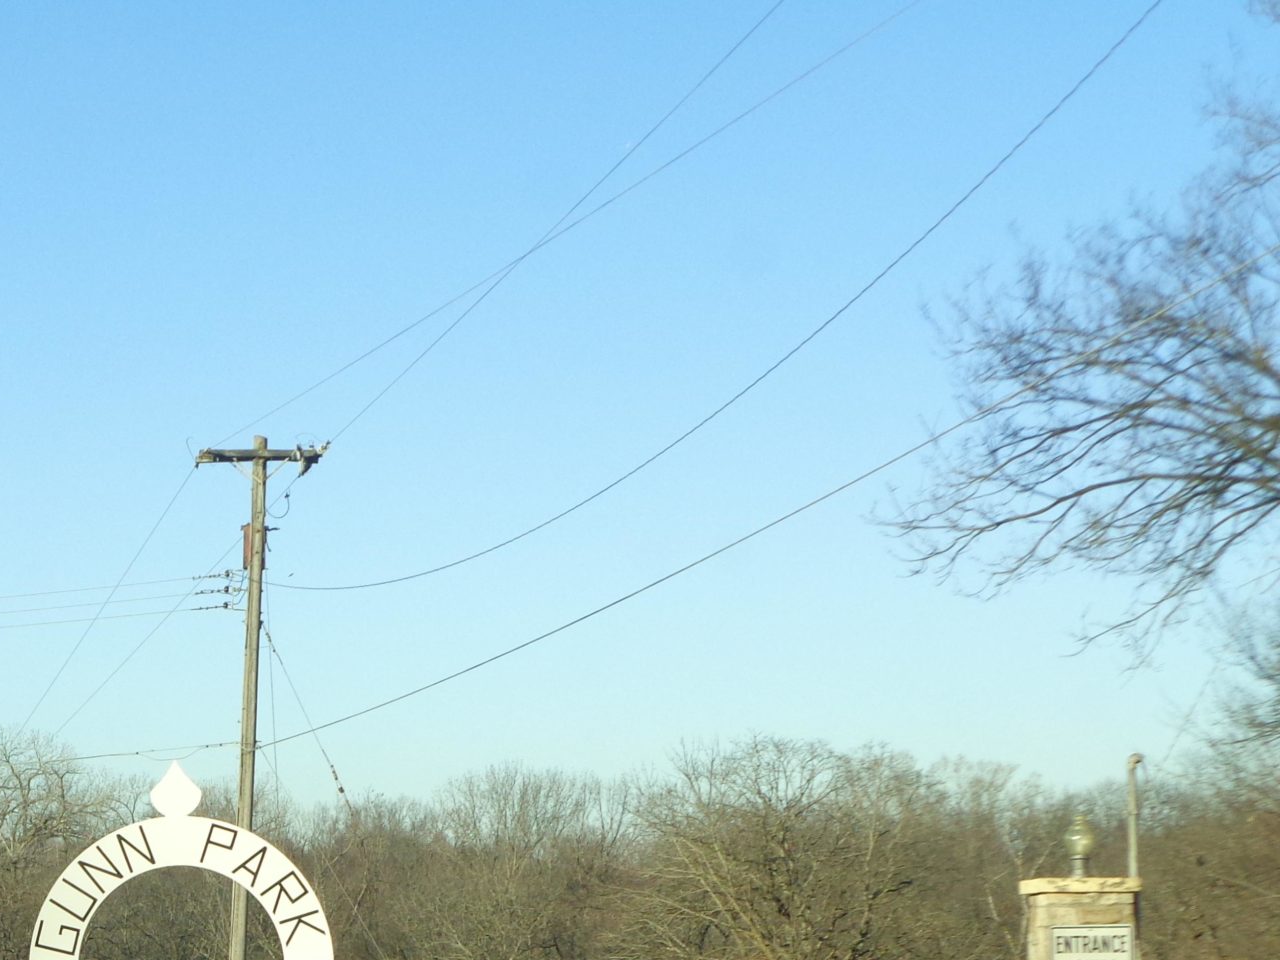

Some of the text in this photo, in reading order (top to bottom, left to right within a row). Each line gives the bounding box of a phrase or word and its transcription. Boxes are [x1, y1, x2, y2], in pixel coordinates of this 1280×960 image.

[34, 823, 326, 956] GUNN PARK
[1056, 934, 1128, 954] ENTRANCE
